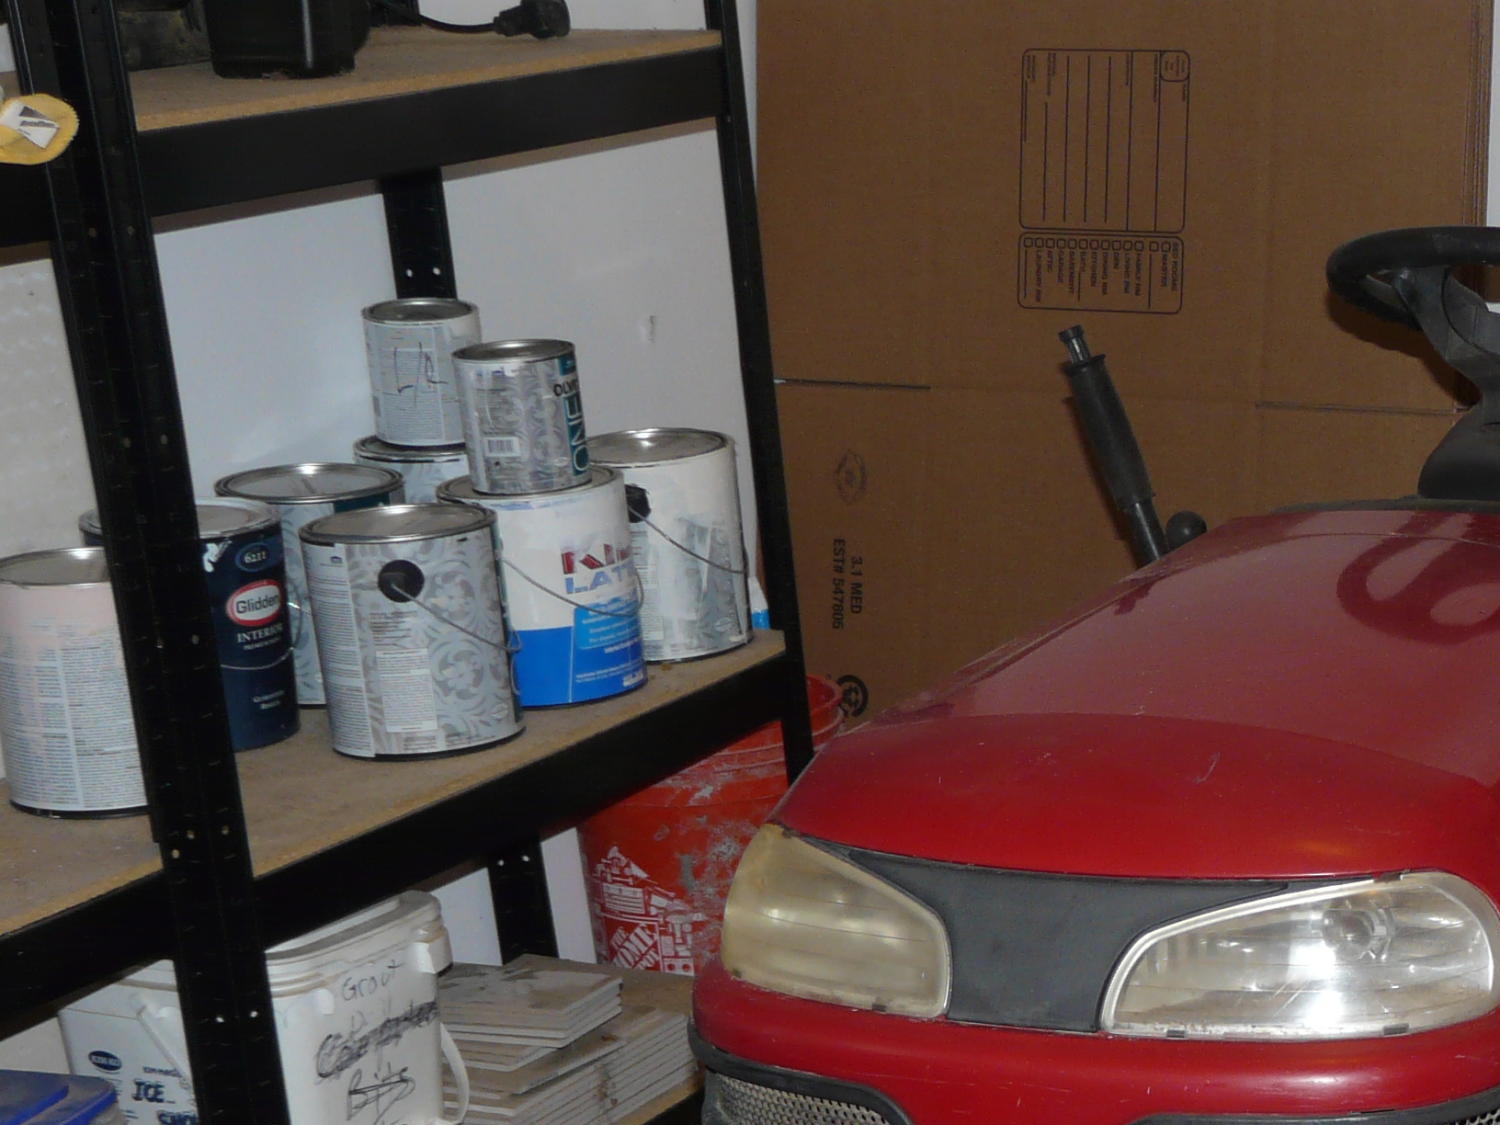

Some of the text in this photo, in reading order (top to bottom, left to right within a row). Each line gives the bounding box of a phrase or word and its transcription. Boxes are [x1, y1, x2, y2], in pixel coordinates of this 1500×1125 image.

[562, 394, 590, 473] ONE
[832, 537, 846, 574] EST#
[236, 593, 281, 614] Glidden
[850, 556, 864, 614] 3.1 MED
[339, 959, 399, 1002] Grout
[132, 1079, 166, 1104] ICE
